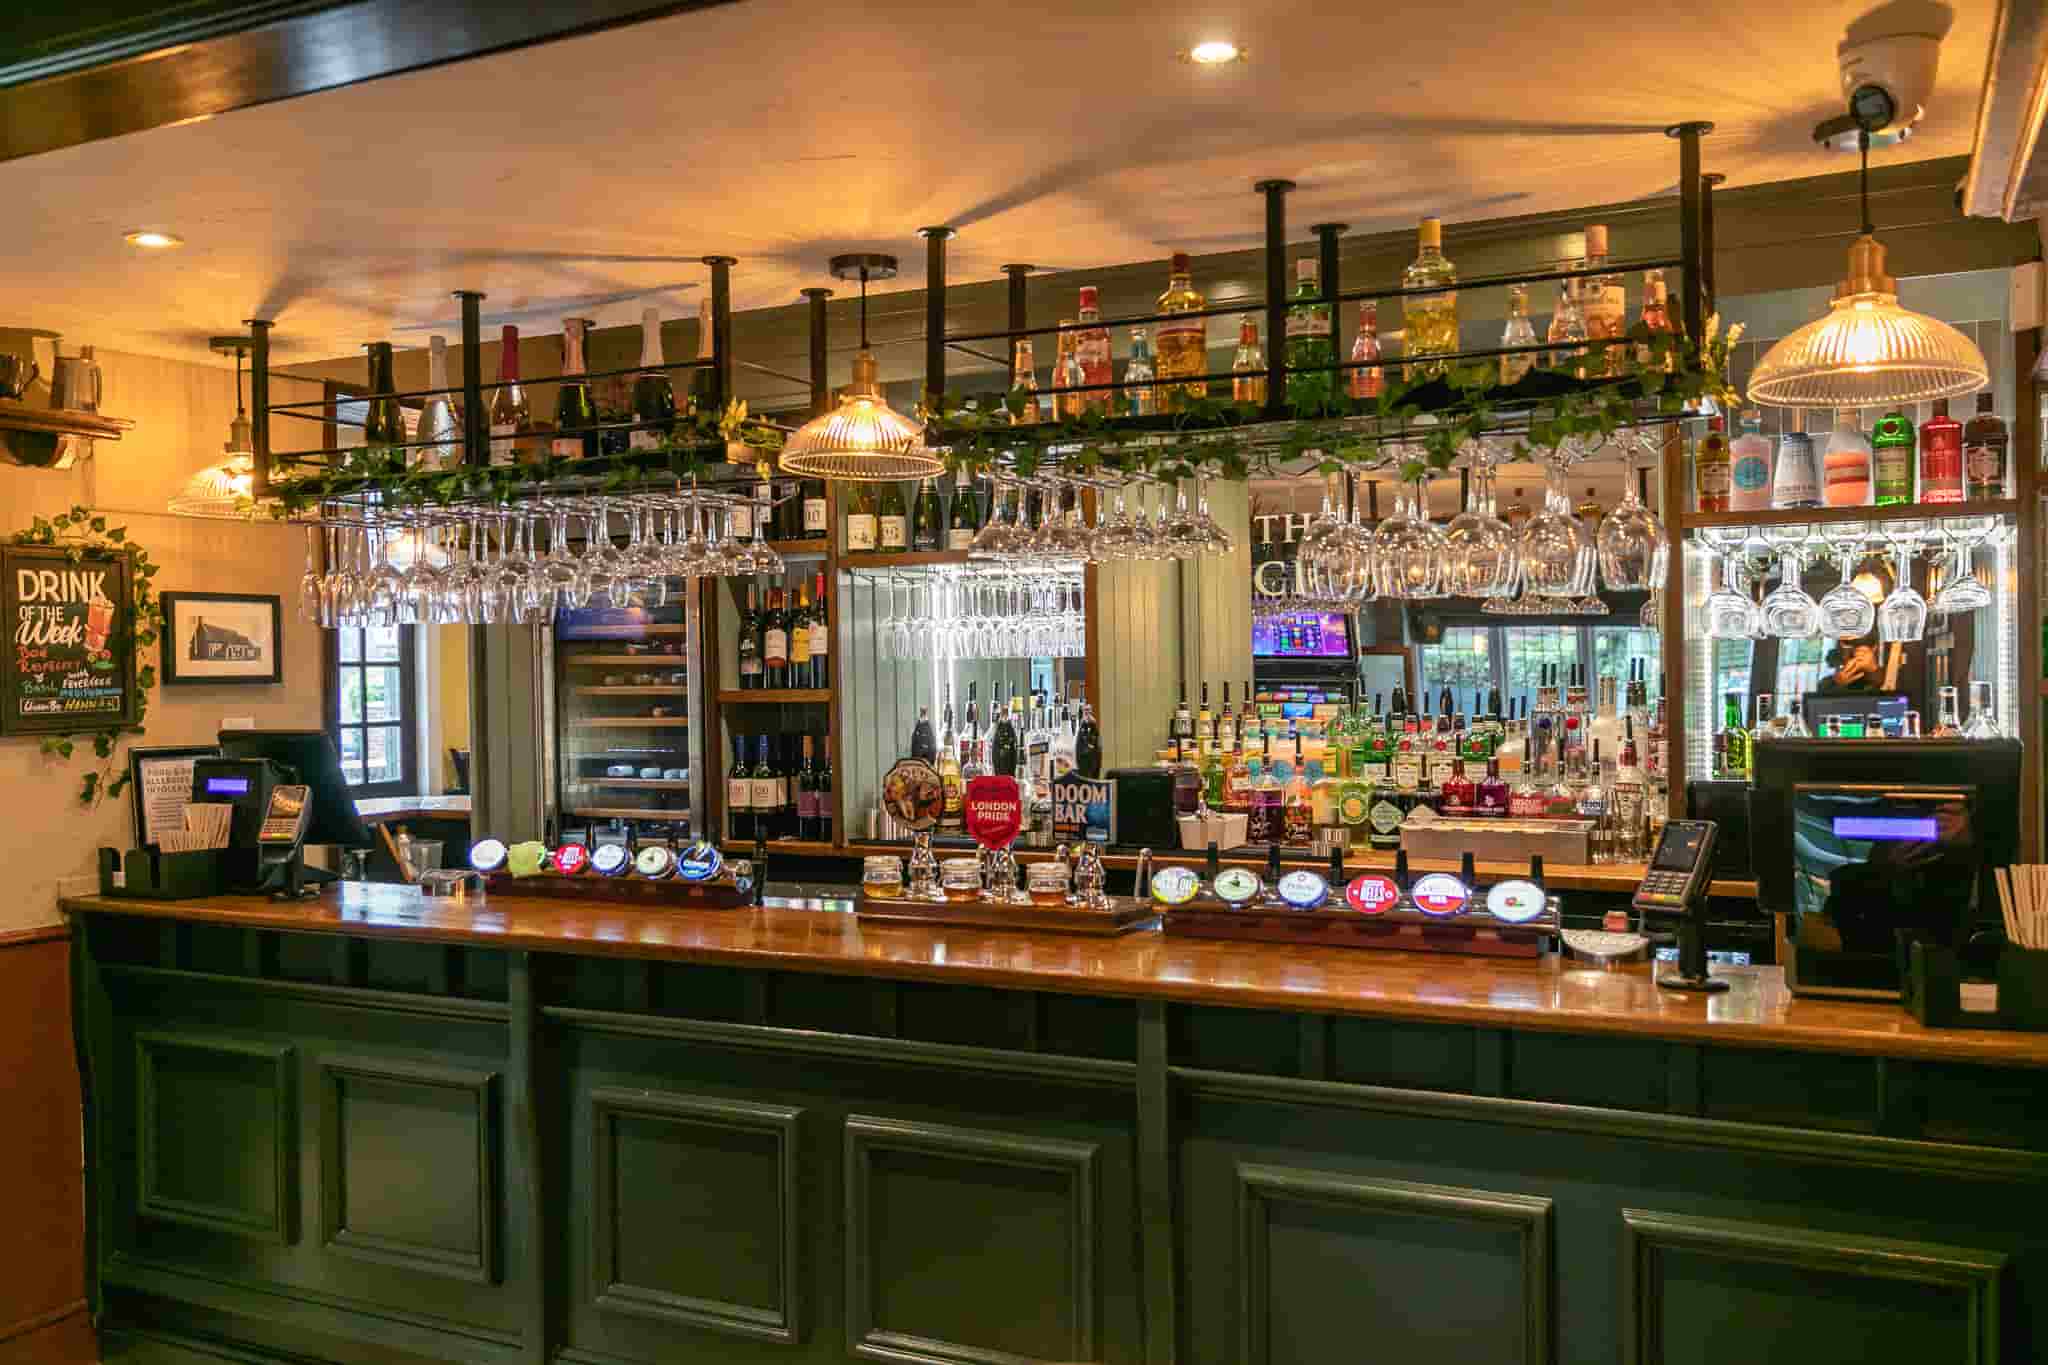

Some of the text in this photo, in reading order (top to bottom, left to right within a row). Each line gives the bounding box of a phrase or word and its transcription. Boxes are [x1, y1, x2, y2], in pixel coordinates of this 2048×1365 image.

[1253, 512, 1322, 545] TH
[16, 568, 107, 603] DRINK
[19, 605, 65, 622] OF THE
[15, 615, 83, 649] Week
[1054, 784, 1107, 804] DOOM
[971, 800, 1017, 811] LONDON
[1054, 804, 1087, 824] BAR
[976, 811, 1010, 821] PRIDE
